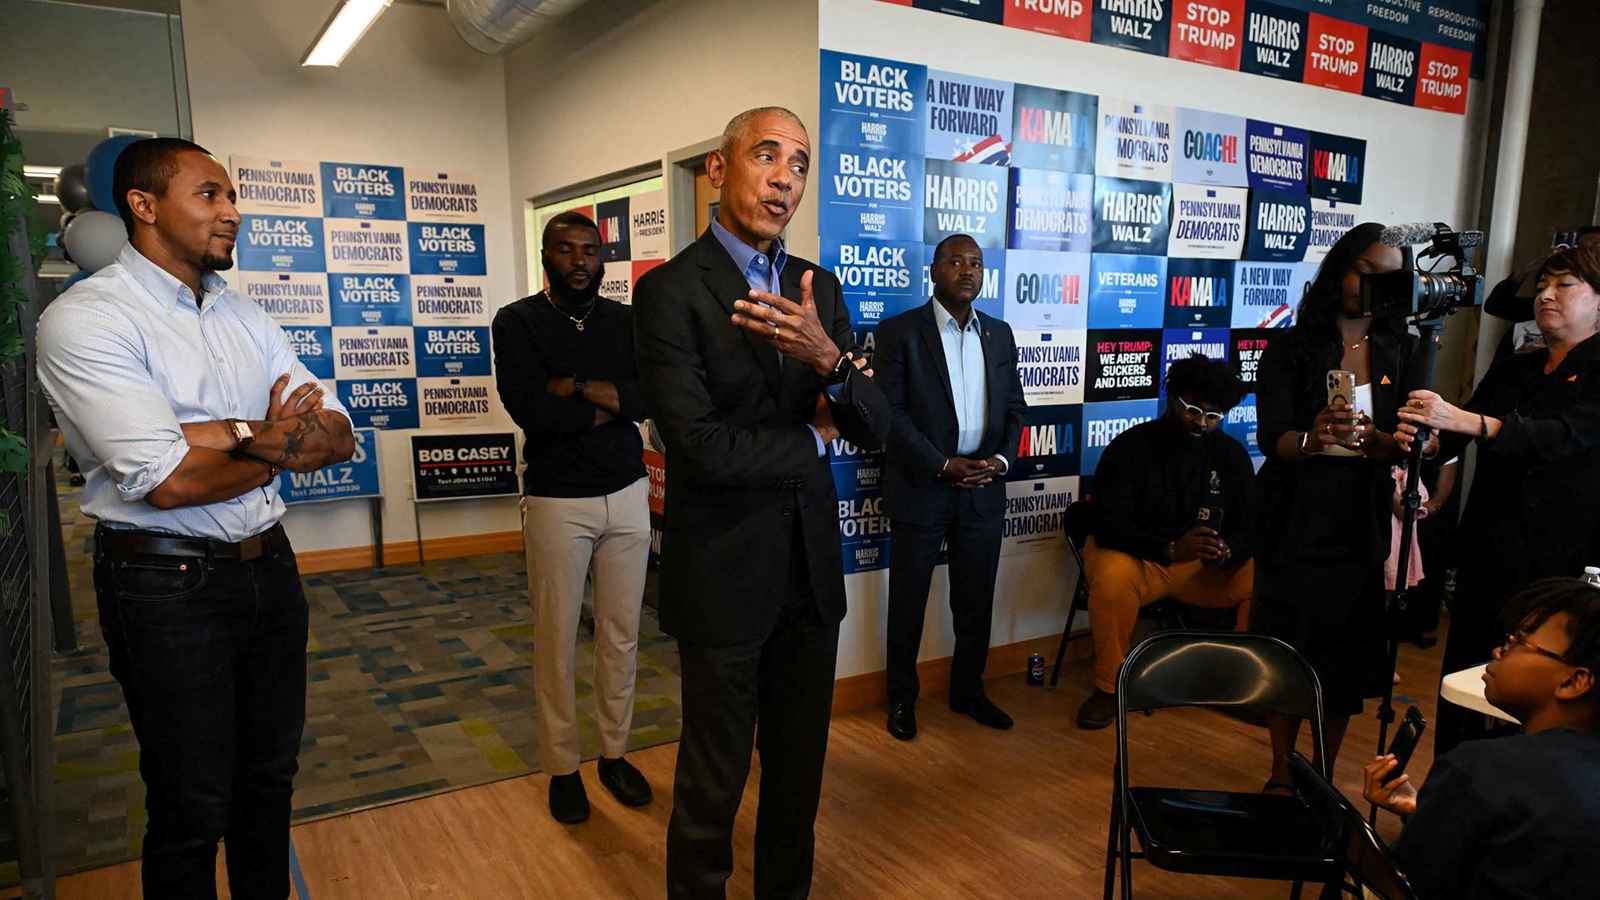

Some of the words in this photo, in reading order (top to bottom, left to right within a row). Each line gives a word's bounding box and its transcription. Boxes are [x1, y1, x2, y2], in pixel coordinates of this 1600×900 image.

[1187, 2, 1230, 27] STOP
[1367, 4, 1409, 24] FREEDOM
[1110, 16, 1152, 40] WALZ
[1178, 22, 1236, 50] TRUMP
[1248, 12, 1300, 51] HARRIS
[1438, 24, 1476, 42] FREEDOM
[1319, 33, 1354, 55] STOP
[1256, 46, 1291, 68] WALZ
[1311, 52, 1359, 76] TRUMP
[1370, 42, 1414, 77] HARRIS
[840, 60, 909, 89] BLACK
[1428, 61, 1458, 79] STOP
[1376, 73, 1405, 92] WALZ
[1421, 78, 1462, 98] TRUMP
[834, 82, 914, 112] VOTERS
[926, 79, 936, 103] A
[939, 81, 972, 108] NEW
[974, 86, 1005, 112] WAY
[930, 106, 998, 137] FORWARD
[1019, 106, 1089, 149] KAMALA
[1104, 114, 1170, 140] PNSYLVANIA
[1184, 130, 1238, 164] COACH!
[1250, 135, 1304, 159] PENNSYLVANIA
[336, 167, 390, 182] BLACK
[840, 154, 906, 180] BLACK
[1250, 154, 1302, 180] DEMOCRATS
[1314, 150, 1358, 184] KAMALA
[238, 168, 315, 186] PENNSYLVANIA
[240, 184, 316, 204] DEMOCRATS
[332, 180, 395, 196] VOTERS
[410, 181, 476, 196] PENNSYLVANIA
[833, 175, 912, 201] VOTERS
[926, 174, 998, 213] HARRIS
[412, 196, 478, 212] DEMOCRATS
[1102, 191, 1162, 225] HARRIS
[1180, 200, 1240, 220] PENNSYLVANIA
[252, 219, 308, 234] BLACK
[633, 209, 664, 228] HARRIS
[937, 213, 986, 233] WALZ
[1016, 208, 1088, 234] DEMOCRATS
[1258, 202, 1306, 234] HARRIS
[1311, 210, 1355, 228] PENNSYLVANIA
[248, 232, 314, 248] VOTERS
[331, 230, 402, 245] PENNSYLVANIA
[422, 226, 471, 240] BLACK
[1112, 224, 1152, 242] WALZ
[1176, 220, 1240, 242] DEMOCRATS
[1310, 229, 1344, 247] DEMOCRA
[418, 238, 476, 253] VOTERS
[1264, 233, 1296, 250] WALZ
[332, 246, 403, 262] DEMOCRATS
[840, 244, 906, 267] BLACK
[343, 277, 396, 290] BLACK
[834, 266, 910, 288] VOTERS
[1098, 272, 1158, 287] VETERANS
[1240, 267, 1248, 285] A
[1250, 267, 1271, 286] NEW
[1272, 268, 1292, 286] WAY
[248, 283, 323, 297] PENNSYLVANIA
[340, 290, 400, 304] VOTERS
[417, 285, 483, 298] PENNSYLVANIA
[1016, 272, 1080, 304] COACH!
[1170, 276, 1226, 306] KAMALA
[1243, 288, 1288, 306] FORWARD
[258, 299, 324, 314] EMOCRATS
[418, 300, 484, 314] DEMOCRATS
[860, 301, 884, 313] HARRIS
[286, 330, 317, 342] ACK
[340, 336, 408, 350] PENNSYLVANIA
[428, 330, 476, 342] BLACK
[292, 343, 322, 356] ERS
[425, 342, 480, 354] VOTERS
[1016, 346, 1080, 364] ENNSYLVANIA
[1097, 342, 1117, 354] HEY
[1240, 350, 1252, 360] WE
[340, 352, 409, 367] DEMOCRATS
[1100, 354, 1115, 366] WE
[1116, 352, 1150, 364] AREN'T
[1017, 366, 1079, 388] EMOCRATS
[1102, 364, 1146, 377] SUCKERS
[352, 382, 402, 396] BLACK
[1094, 378, 1114, 389] AND
[1116, 376, 1152, 388] LOSERS
[349, 395, 408, 408] VOTERS
[424, 386, 488, 400] PENNSYLVANIA
[425, 400, 488, 416] DEMOCRATS
[1017, 424, 1074, 458] AMALA
[1088, 417, 1153, 448] FREED
[419, 449, 455, 462] BOB
[458, 447, 510, 460] CASEY
[290, 467, 354, 488] WALZ
[420, 468, 446, 476] U.S.
[465, 466, 512, 474] SENATE
[838, 498, 882, 518] BLAC
[1005, 492, 1072, 514] PENNSYLVANIA
[840, 516, 892, 538] OTER
[1004, 512, 1066, 538] DEMOCRAT
